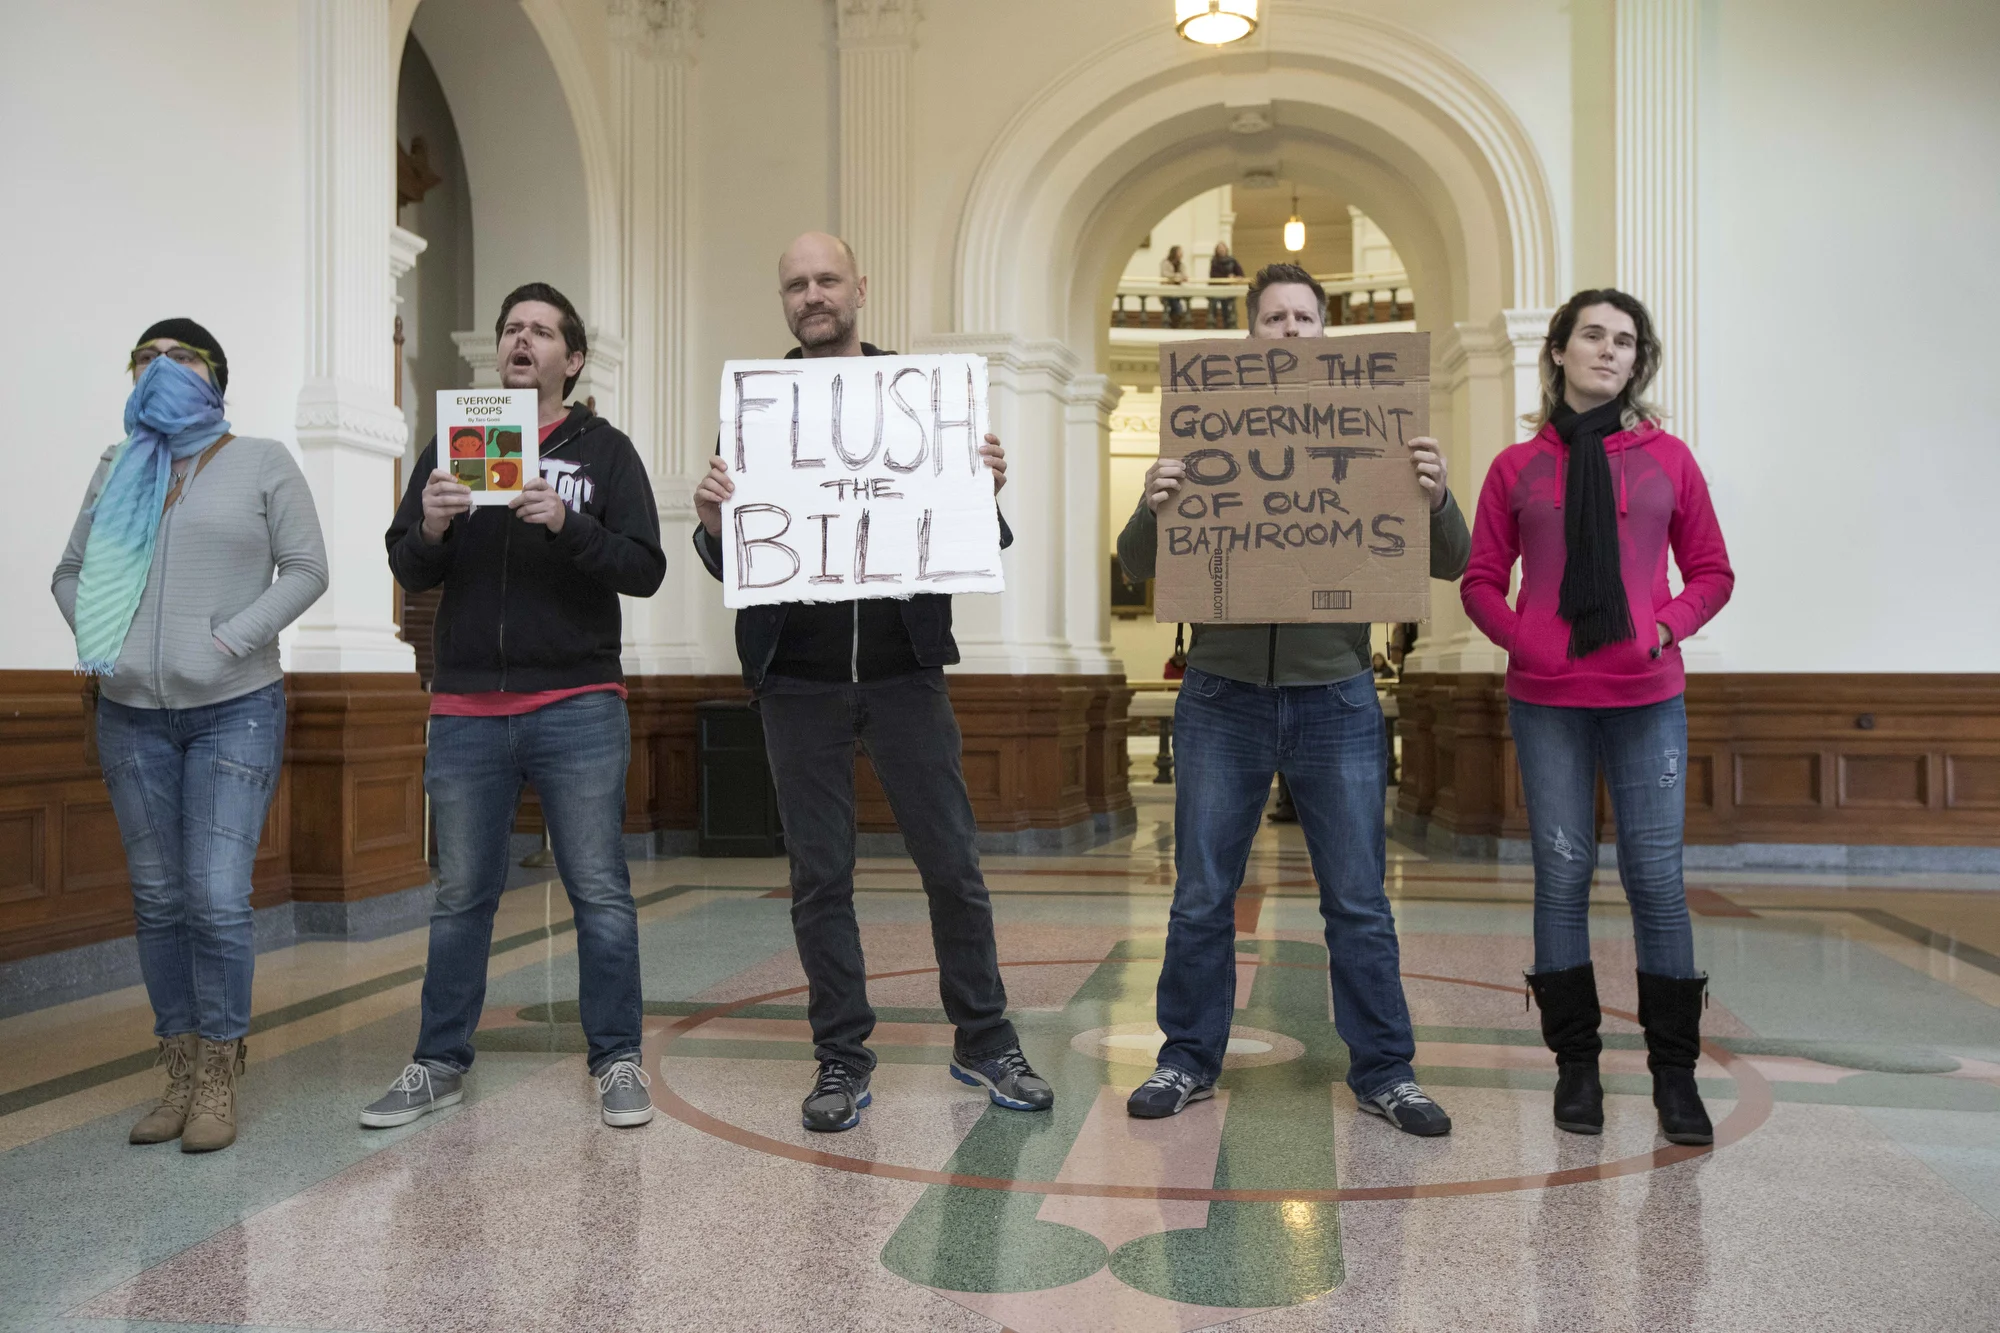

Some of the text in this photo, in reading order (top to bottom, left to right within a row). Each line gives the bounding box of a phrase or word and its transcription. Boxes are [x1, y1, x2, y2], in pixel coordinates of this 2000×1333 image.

[1169, 348, 1405, 395] KEEP THE
[456, 396, 512, 405] EVERYONE
[465, 406, 503, 415] POOPS
[734, 363, 980, 477] FLUSH
[1170, 403, 1413, 446] GOVERNMENT
[1183, 445, 1385, 486] OUT
[820, 477, 904, 501] THE
[1178, 488, 1349, 519] OF OUR
[734, 503, 996, 590] BILL
[1165, 513, 1406, 557] BATHROOMS
[1213, 548, 1223, 619] amazon.com
